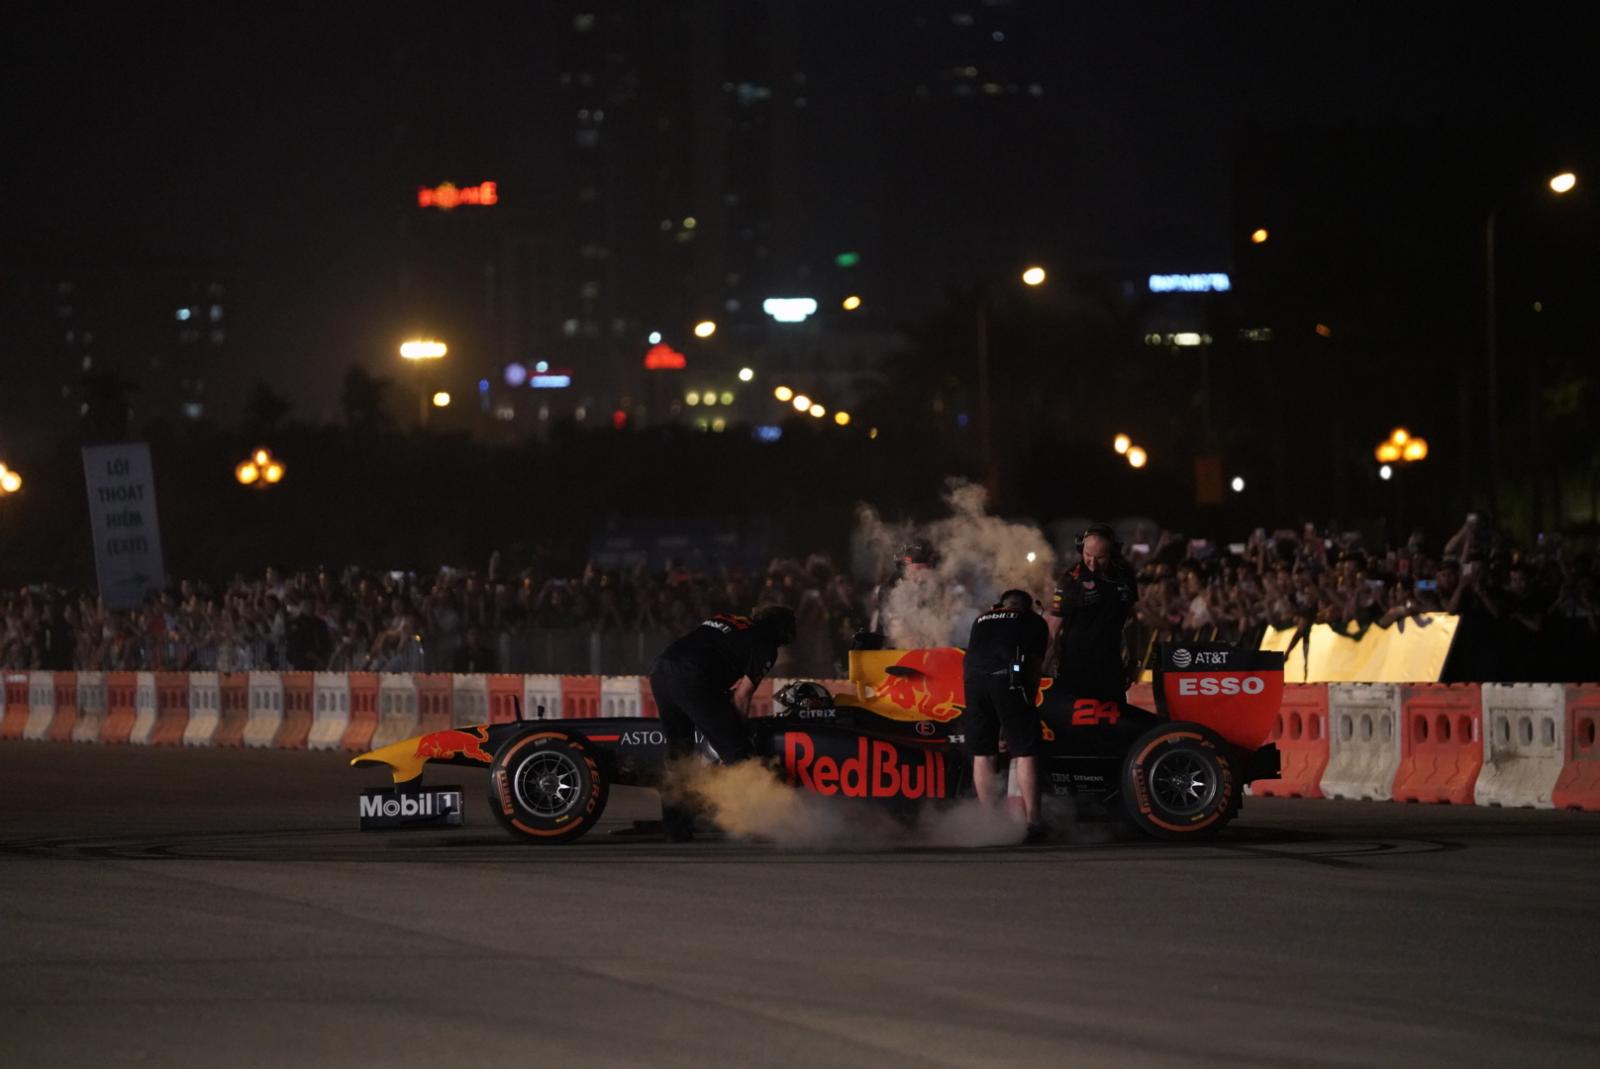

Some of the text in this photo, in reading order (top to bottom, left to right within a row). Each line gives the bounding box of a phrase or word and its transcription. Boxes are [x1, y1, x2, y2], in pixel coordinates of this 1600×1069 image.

[1194, 651, 1229, 664] AT&T
[1179, 676, 1265, 696] ESSO
[1071, 697, 1121, 727] 24
[359, 790, 432, 817] Mobil
